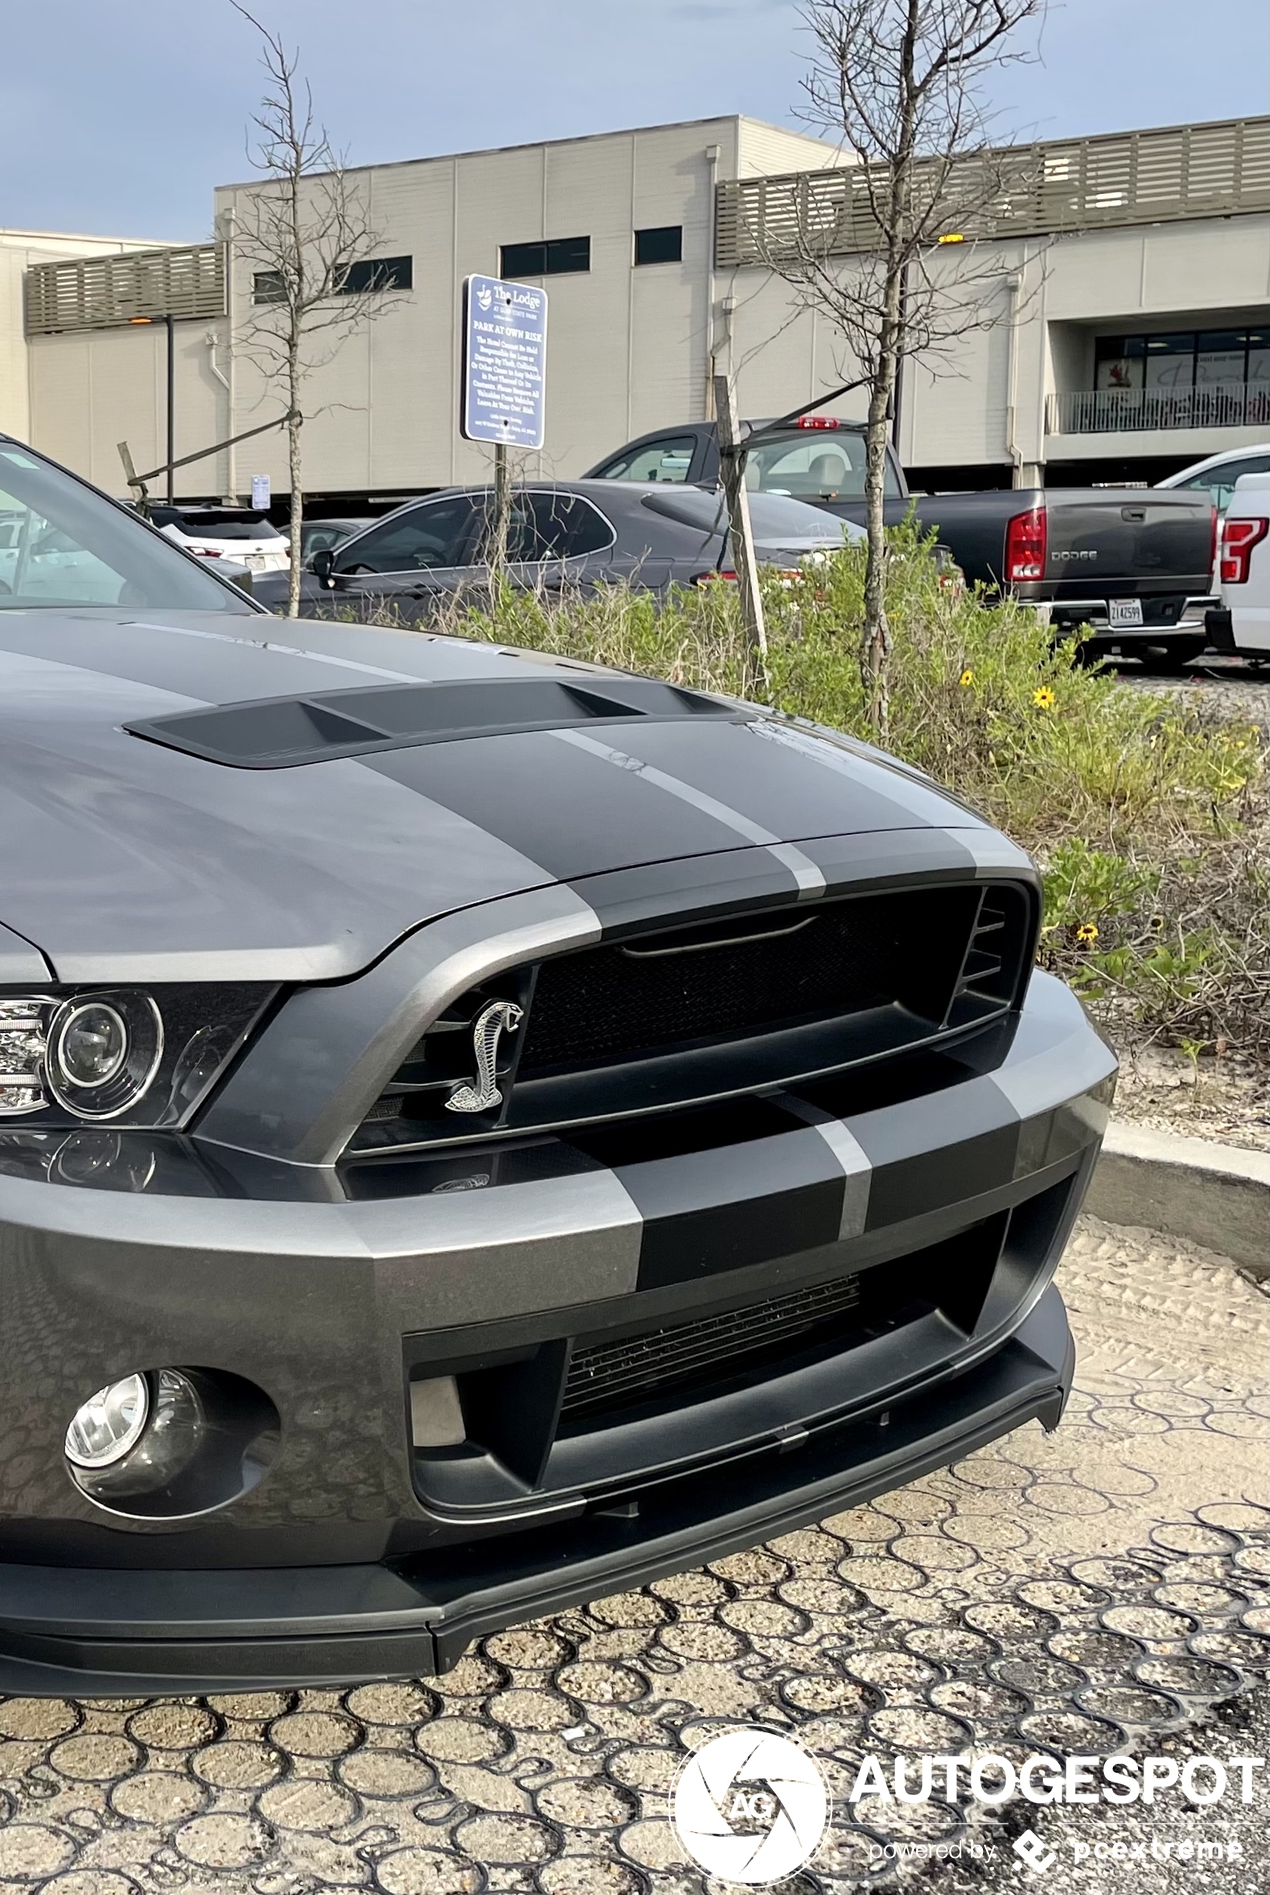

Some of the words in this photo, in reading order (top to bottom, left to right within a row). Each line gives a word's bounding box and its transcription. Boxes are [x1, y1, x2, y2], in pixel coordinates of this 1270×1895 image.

[494, 286, 511, 299] The
[514, 290, 540, 309] Lodge
[474, 320, 494, 332] PARK
[495, 325, 505, 335] AT
[505, 327, 524, 339] OWN
[525, 331, 542, 342] RISK
[1051, 550, 1097, 561] DODGE
